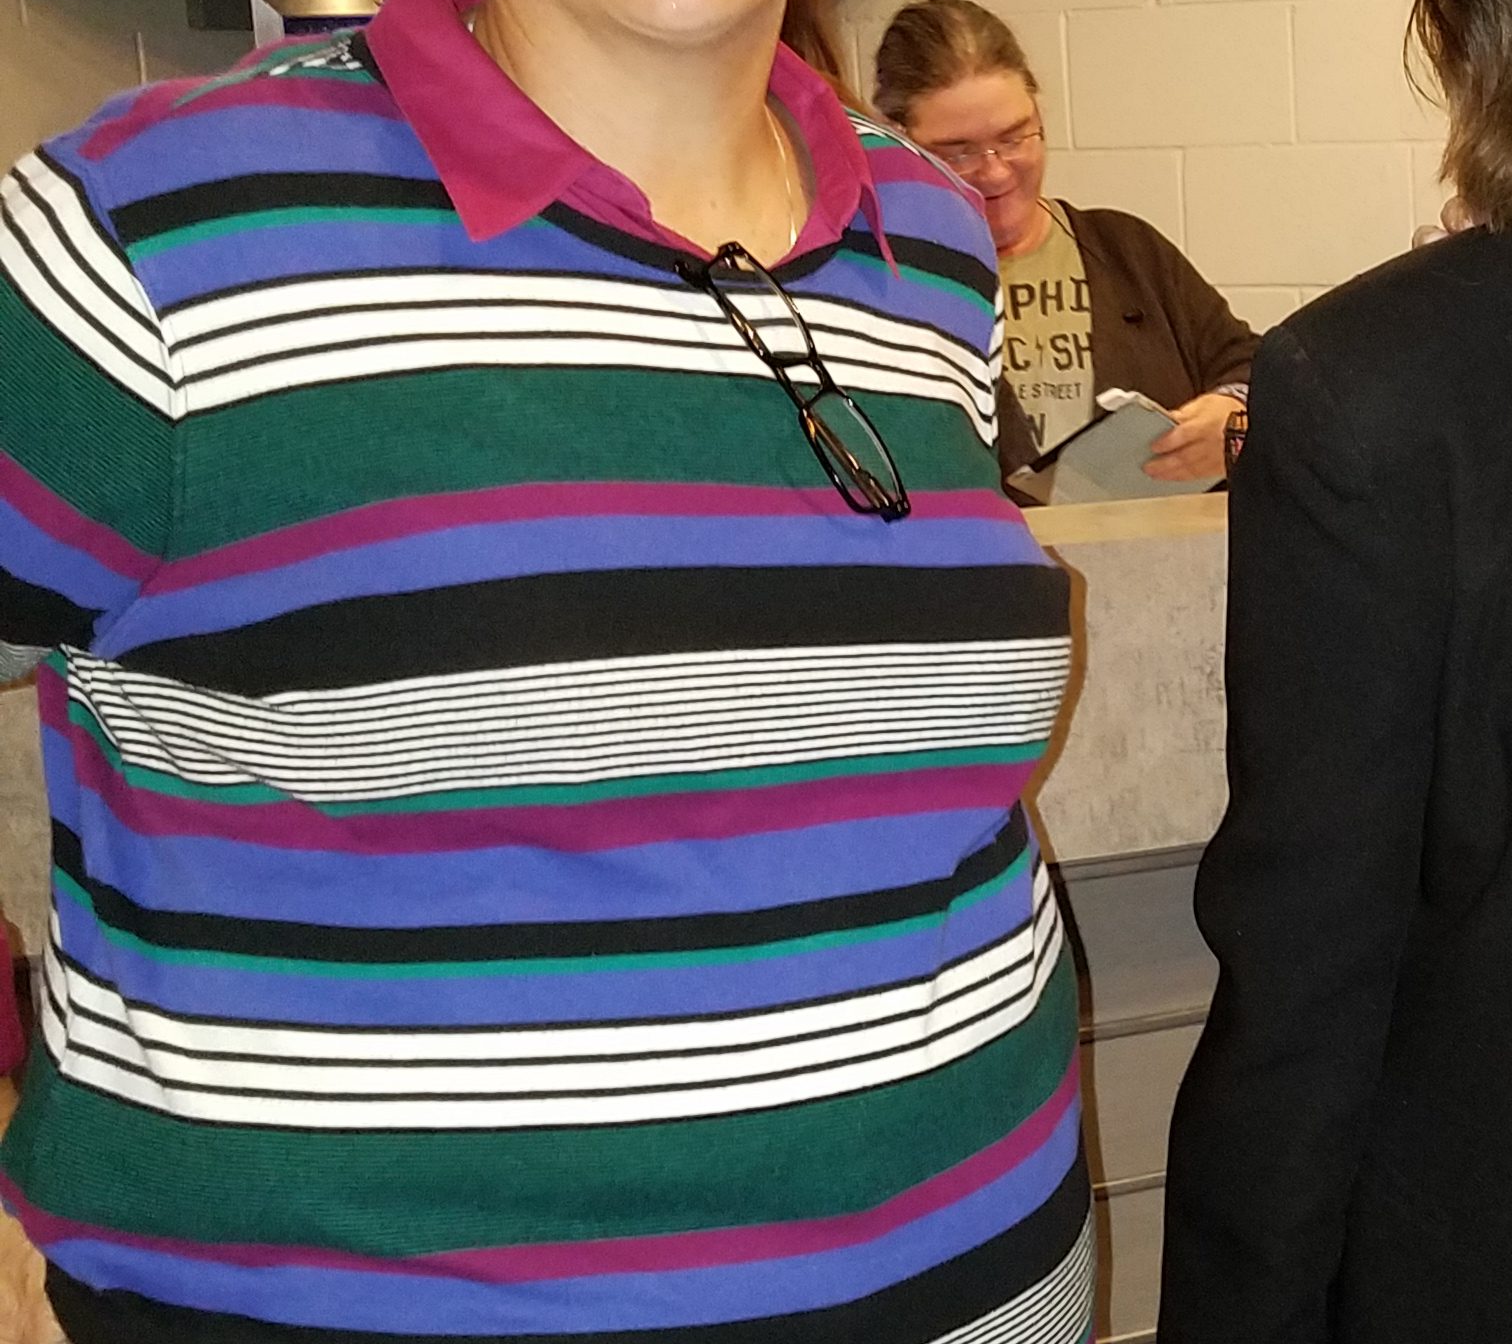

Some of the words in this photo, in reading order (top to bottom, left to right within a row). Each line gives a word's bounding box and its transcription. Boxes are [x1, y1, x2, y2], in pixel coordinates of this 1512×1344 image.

[1004, 276, 1091, 320] PHI
[1003, 337, 1031, 371] C
[1032, 382, 1082, 400] STREET
